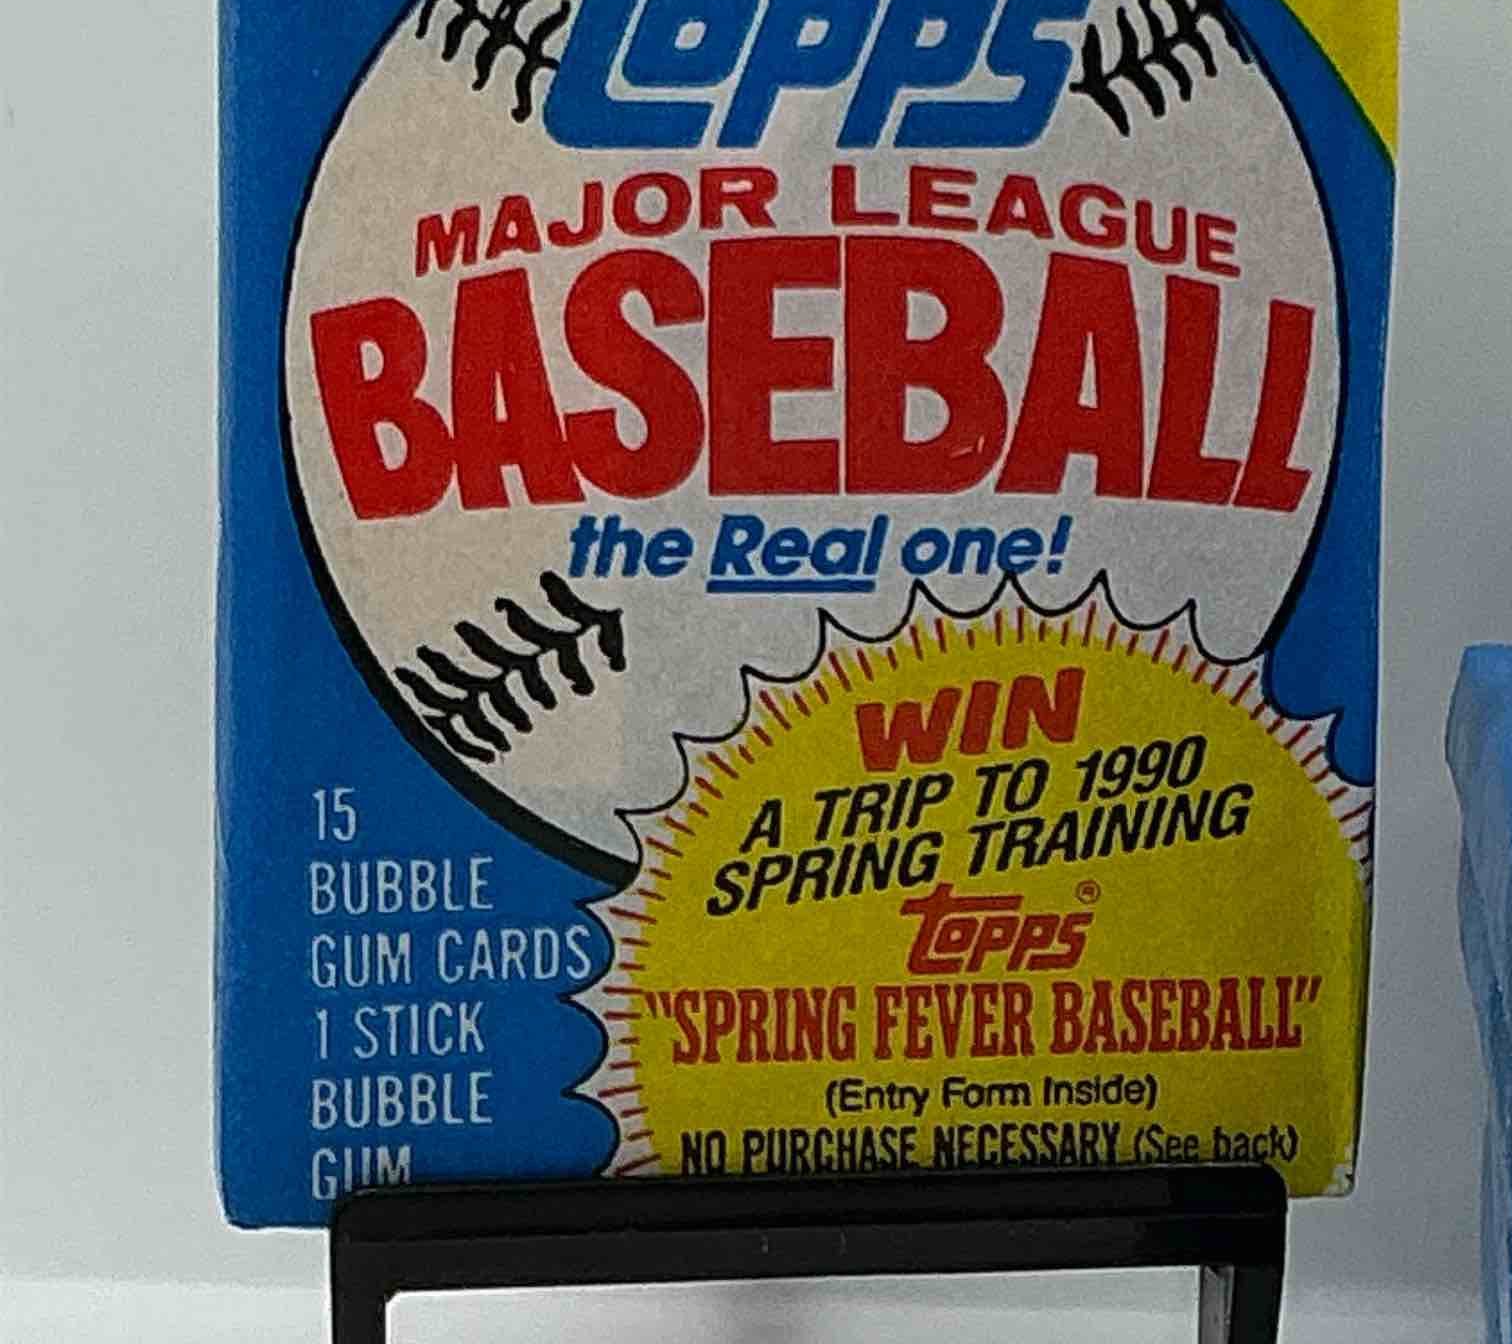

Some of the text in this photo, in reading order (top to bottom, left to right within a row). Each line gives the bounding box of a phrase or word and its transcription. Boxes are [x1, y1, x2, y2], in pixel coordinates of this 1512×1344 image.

[414, 165, 1242, 278] MAJOR LEAGUE
[309, 235, 1316, 520] BASEBALL
[567, 513, 1073, 594] the Real one!
[855, 666, 1085, 773] WIN
[312, 787, 356, 841] 15
[740, 734, 1206, 853] A TRIP TO 1990
[309, 856, 494, 915] BUBBLE
[706, 782, 1254, 917] SPRING TRAINING
[311, 924, 593, 988] GUM CARDS
[315, 1000, 486, 1060] 1 STICK
[873, 981, 1034, 1059] FEVER
[1048, 975, 1322, 1054] BASEBALL"
[310, 1071, 494, 1131] BUBBLE
[824, 1073, 1158, 1116] (Entry Form Inside)
[680, 1120, 1299, 1176] NO PURCHASE NECESSARY (See back)
